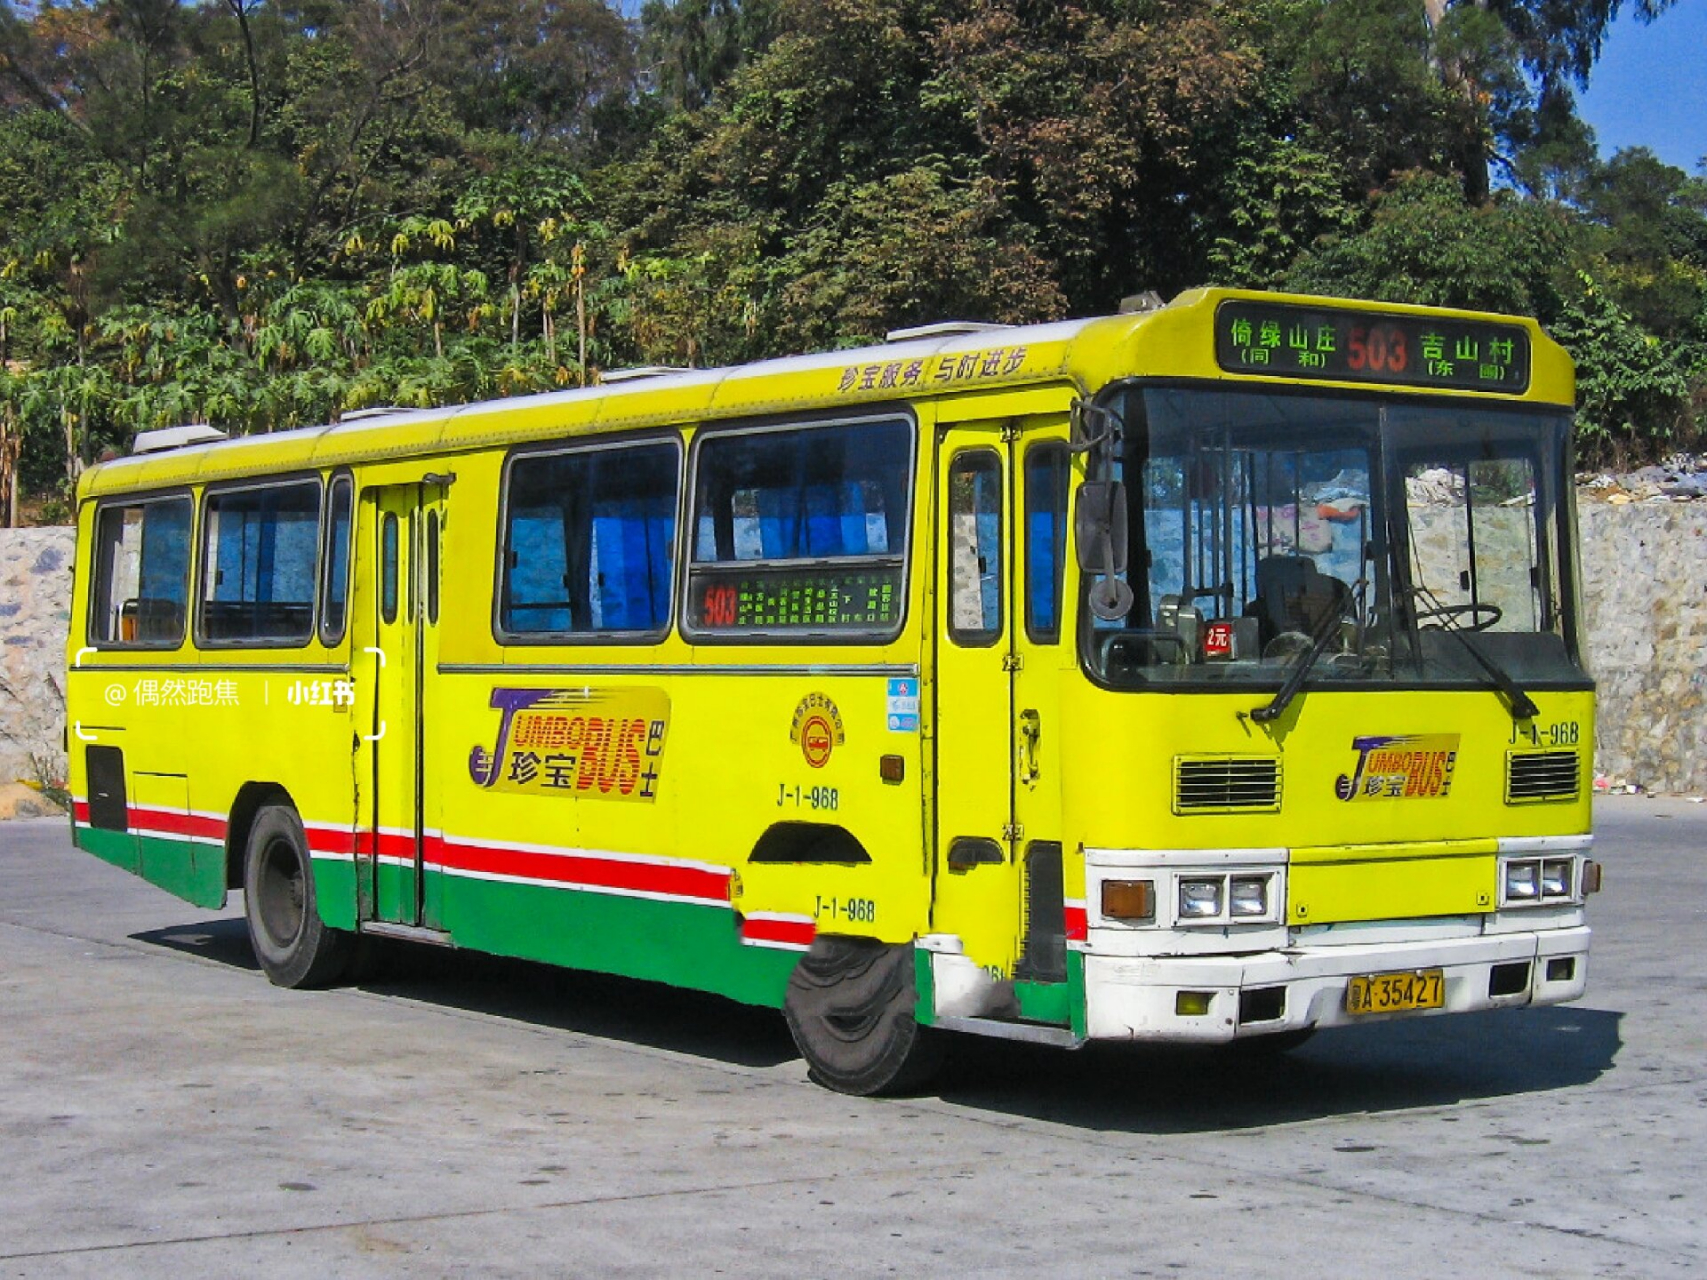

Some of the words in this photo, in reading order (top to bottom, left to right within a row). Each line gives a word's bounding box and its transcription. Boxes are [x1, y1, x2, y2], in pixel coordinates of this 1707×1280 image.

[1347, 325, 1408, 372] 503
[1420, 333, 1514, 364] 吉山村
[704, 583, 737, 626] 503
[1207, 628, 1227, 647] 2元
[1508, 721, 1580, 746] J-1-968
[777, 783, 839, 811] J-1-968
[814, 895, 875, 923] J-1-968
